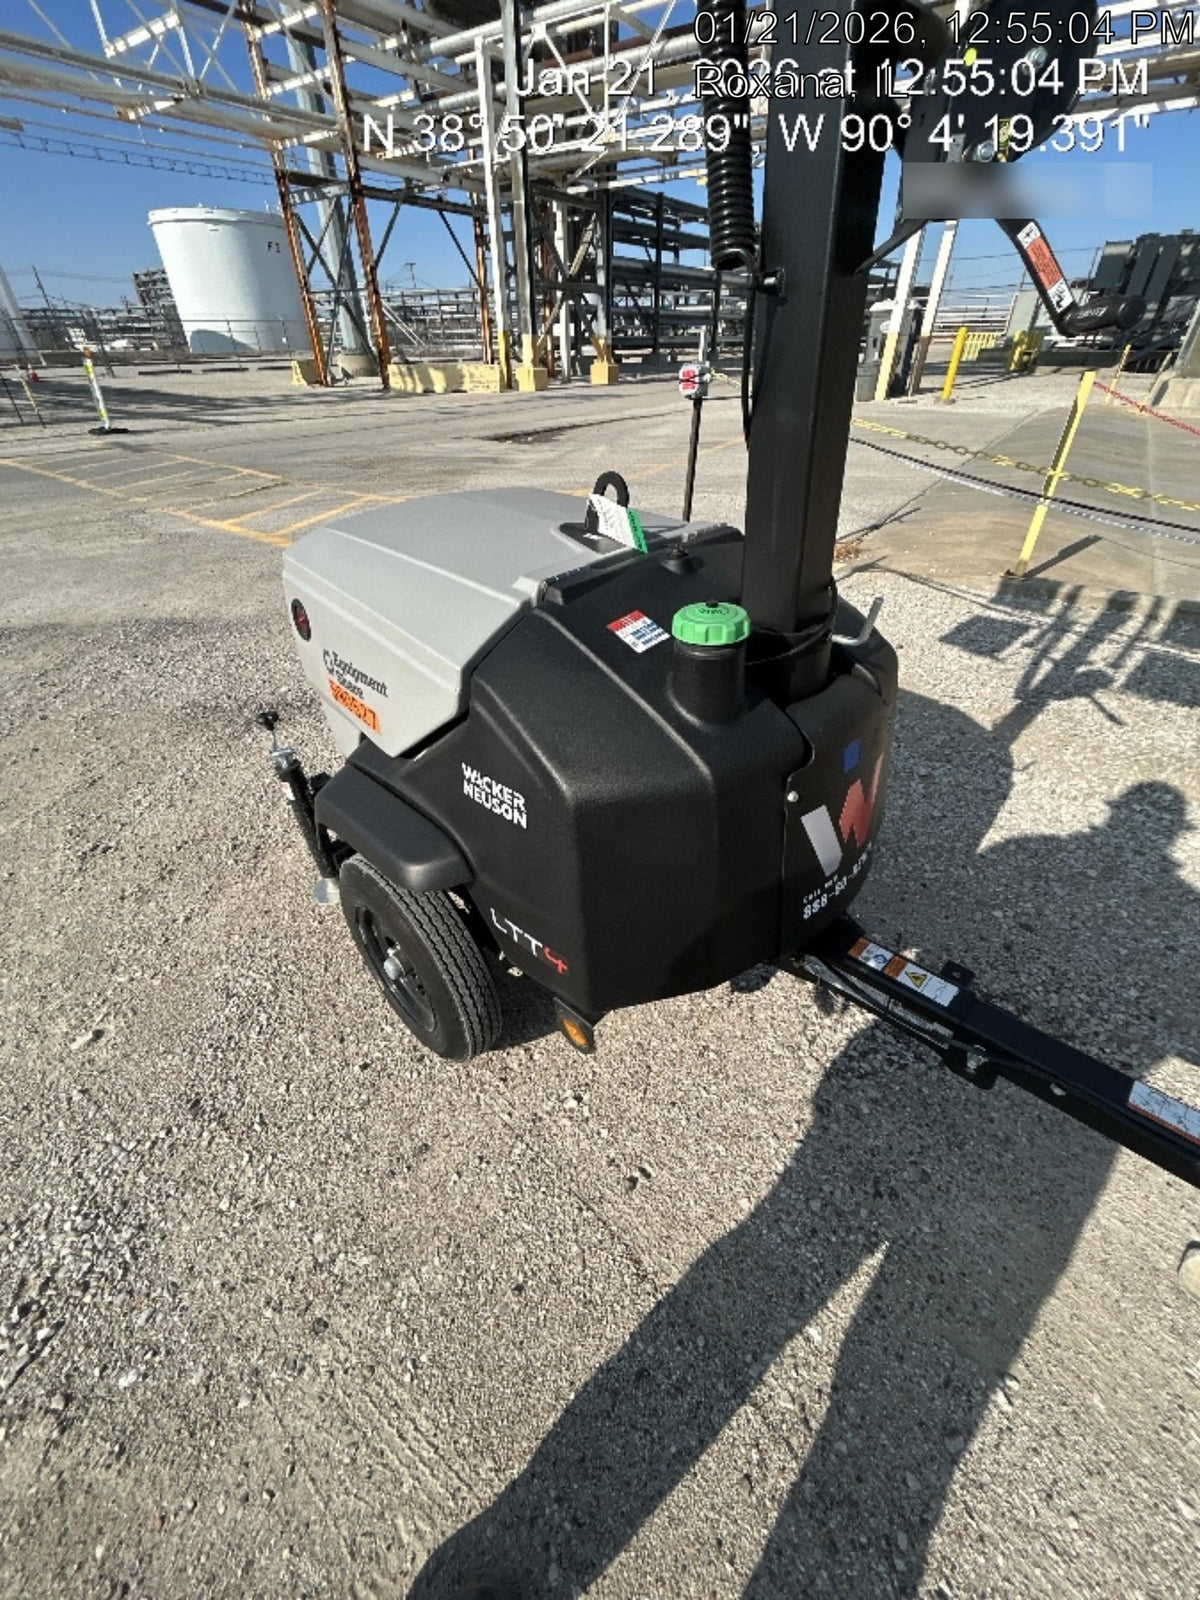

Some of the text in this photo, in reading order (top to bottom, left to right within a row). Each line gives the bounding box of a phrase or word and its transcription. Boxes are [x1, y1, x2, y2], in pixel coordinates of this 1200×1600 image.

[461, 761, 526, 812] WACKER
[462, 781, 528, 830] NEUSON
[489, 907, 568, 975] LTT4
